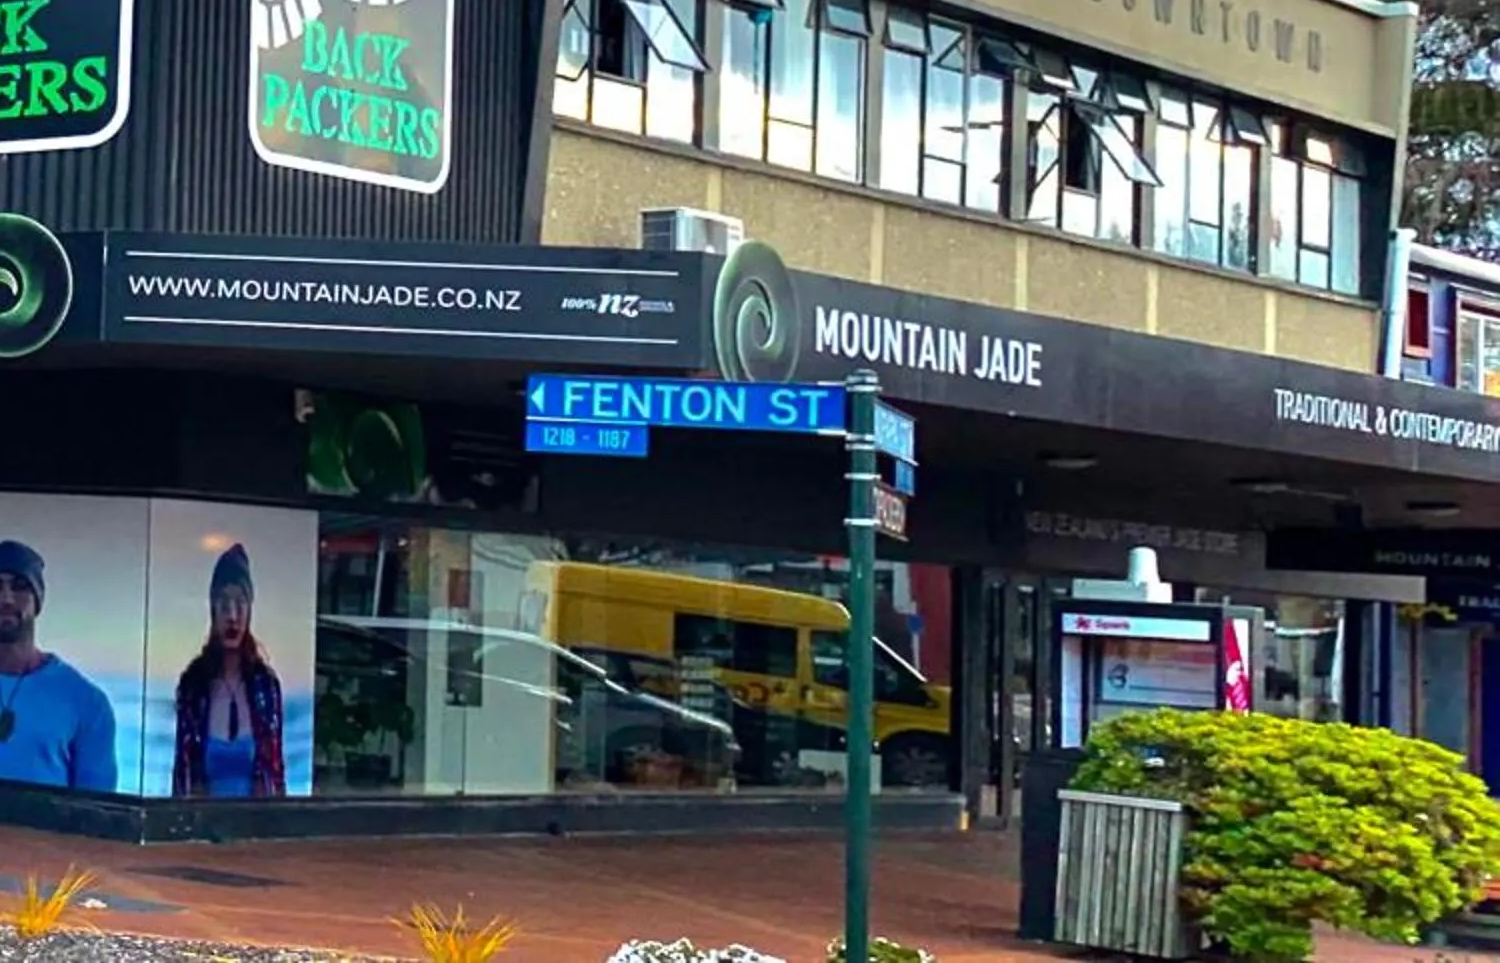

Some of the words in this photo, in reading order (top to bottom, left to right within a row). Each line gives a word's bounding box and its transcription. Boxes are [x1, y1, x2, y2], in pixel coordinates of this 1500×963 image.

[300, 19, 411, 91] BACK
[261, 73, 440, 160] PACKERS
[128, 275, 522, 311] WWW.MOUNTAINJADE.CO.NZ
[815, 305, 967, 376] MOUNTAIN
[974, 335, 1043, 387] JADE
[563, 381, 746, 423] FENTON
[768, 388, 829, 427] ST
[1274, 388, 1373, 433] TRADITIONAL
[1374, 406, 1387, 436] &
[543, 427, 577, 445] 1218
[598, 428, 631, 449] 1187
